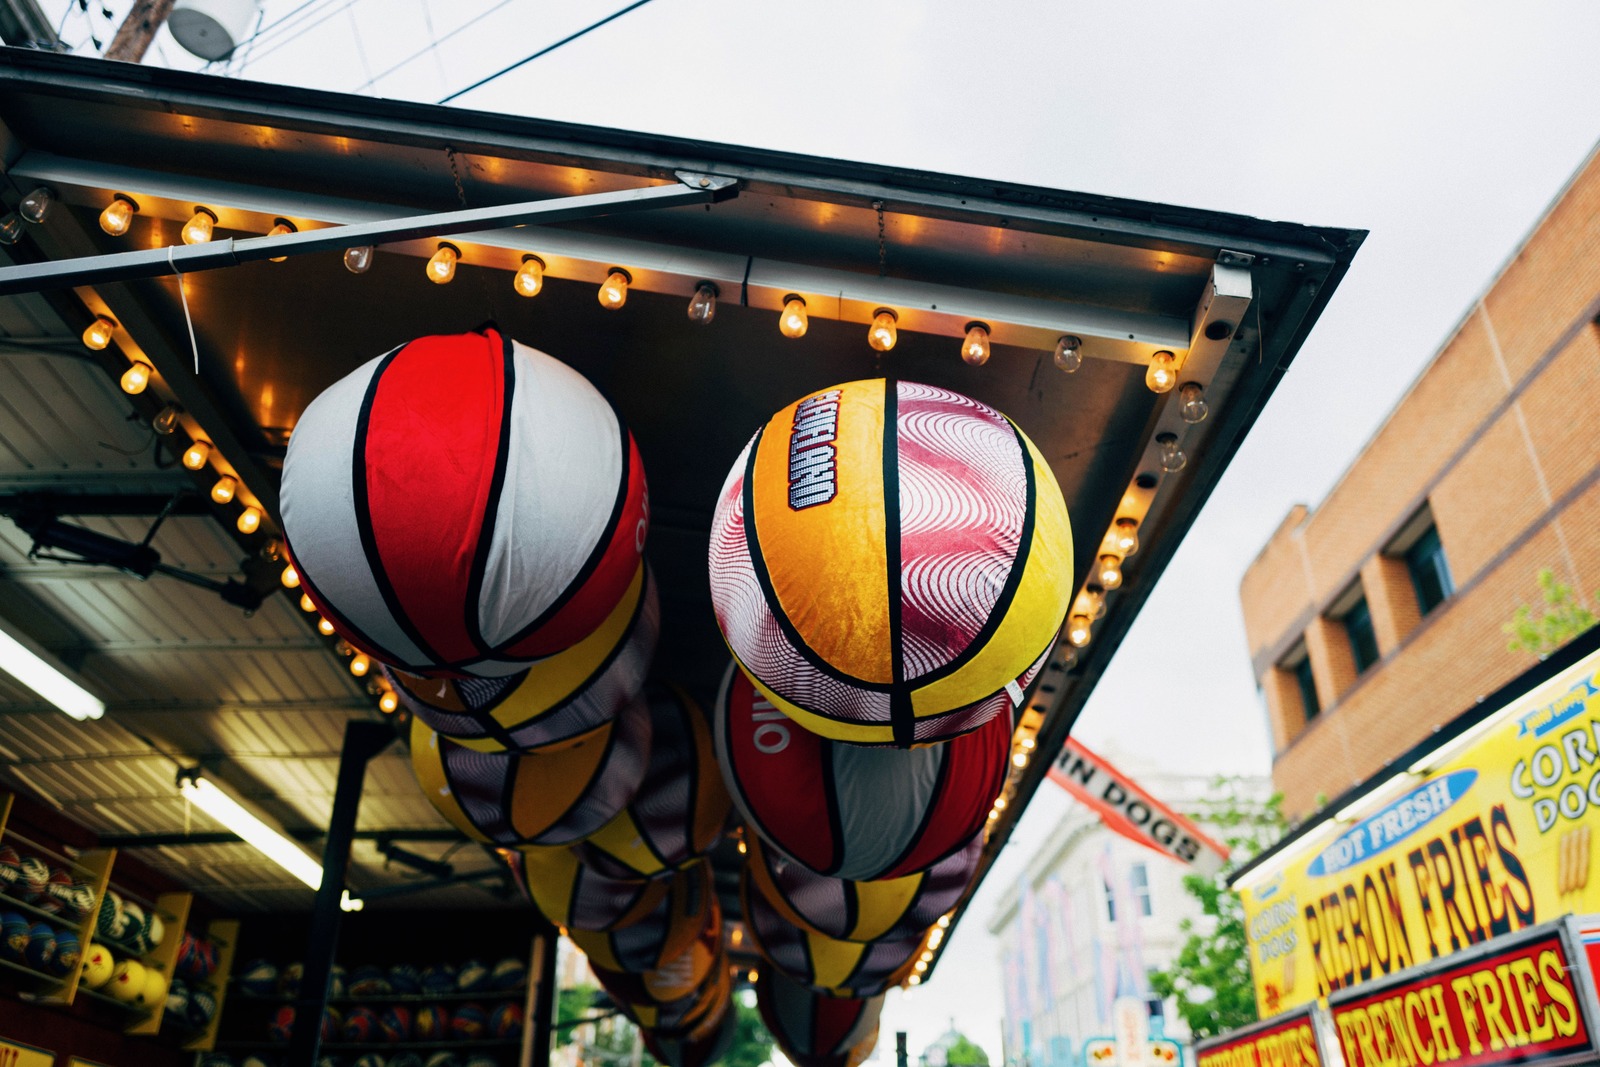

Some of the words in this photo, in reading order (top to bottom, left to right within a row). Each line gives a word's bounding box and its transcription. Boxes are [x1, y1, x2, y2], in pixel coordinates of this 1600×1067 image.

[1102, 780, 1201, 862] DOGS
[1322, 829, 1366, 875] HOT
[1367, 775, 1454, 850] FRESH
[1304, 861, 1416, 1000] RIBBON
[1408, 802, 1537, 961] FRIES
[1336, 983, 1462, 1067] FRENCH
[1450, 949, 1578, 1056] FRIES
